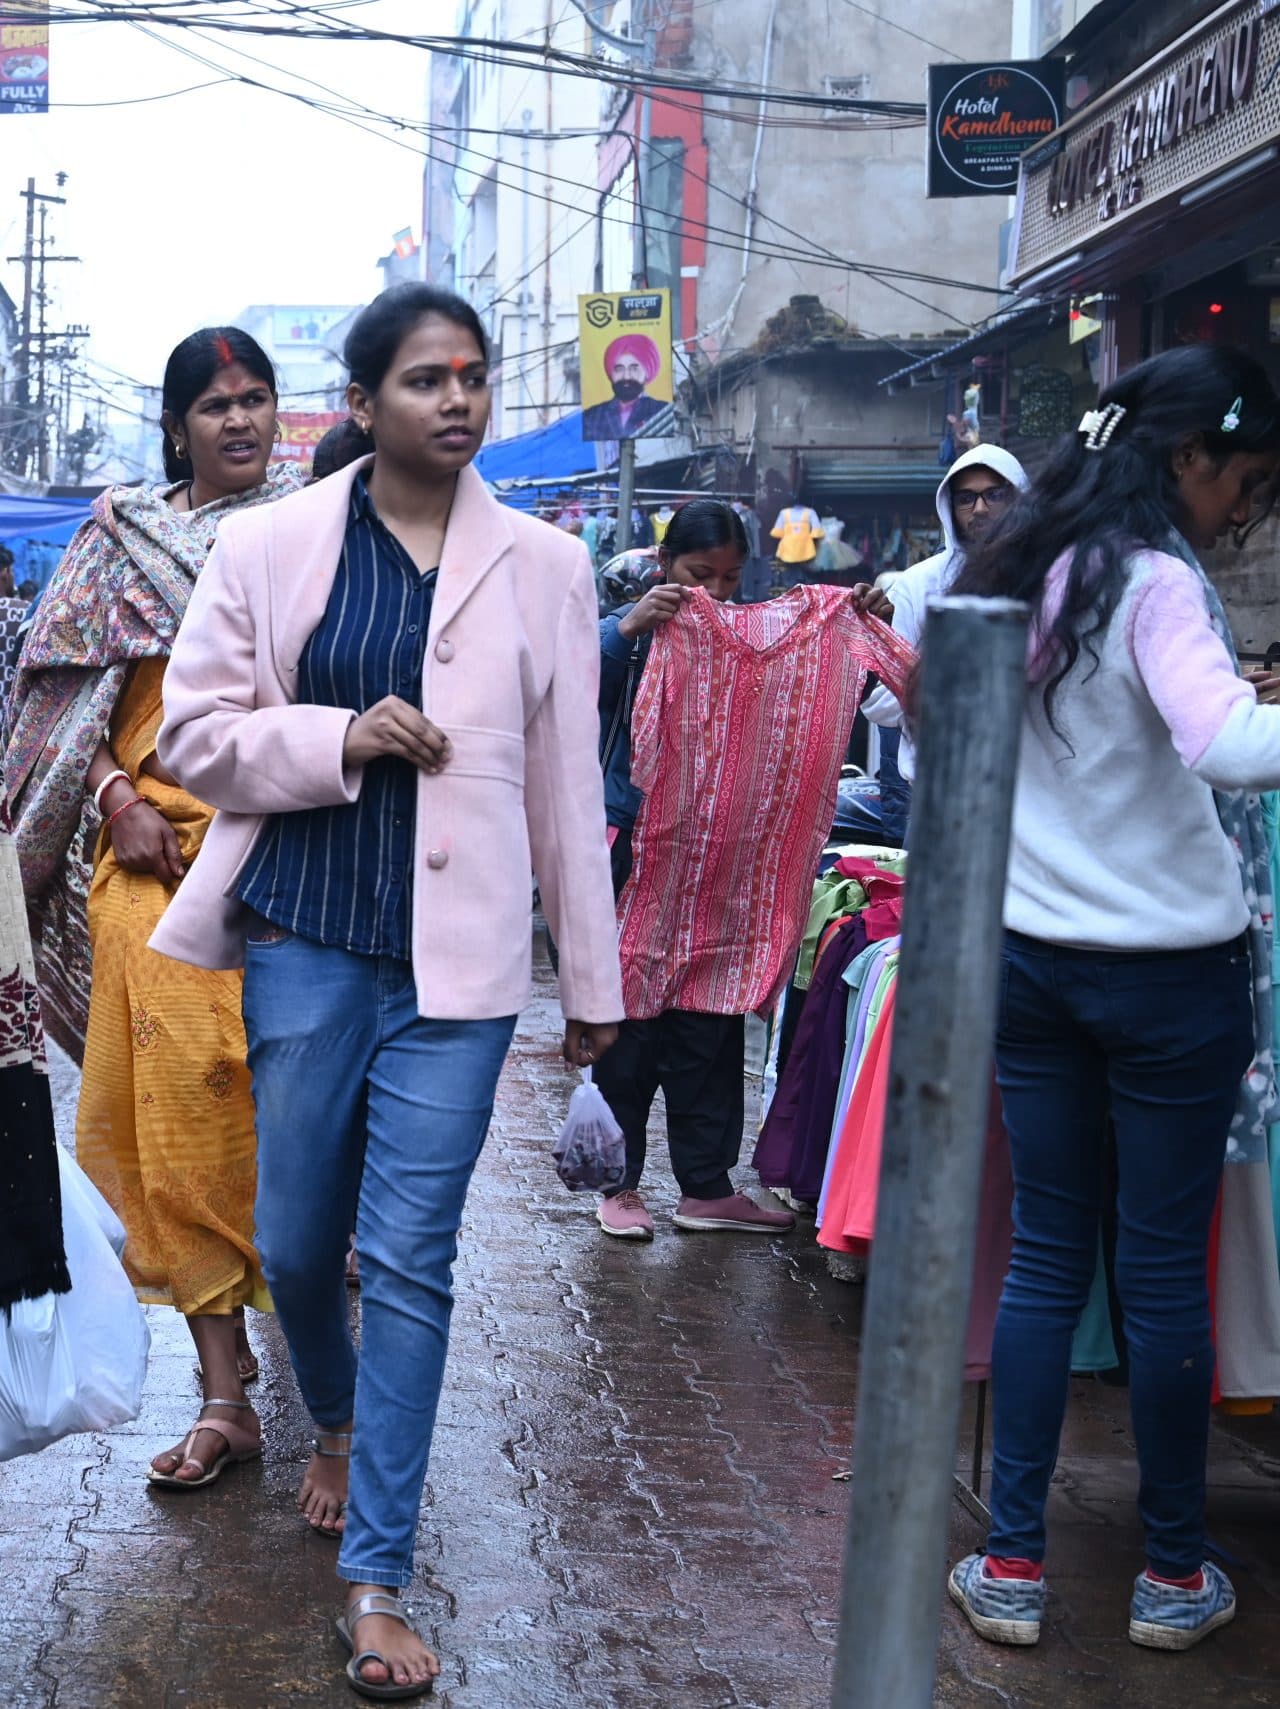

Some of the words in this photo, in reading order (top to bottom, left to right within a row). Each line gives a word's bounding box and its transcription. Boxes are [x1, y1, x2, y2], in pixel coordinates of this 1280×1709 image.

[1, 86, 46, 99] FULLY
[1114, 19, 1256, 176] KAMDHENU
[954, 97, 999, 115] Hotel
[941, 112, 1053, 141] Kamdhenu
[1006, 156, 1020, 164] LUN
